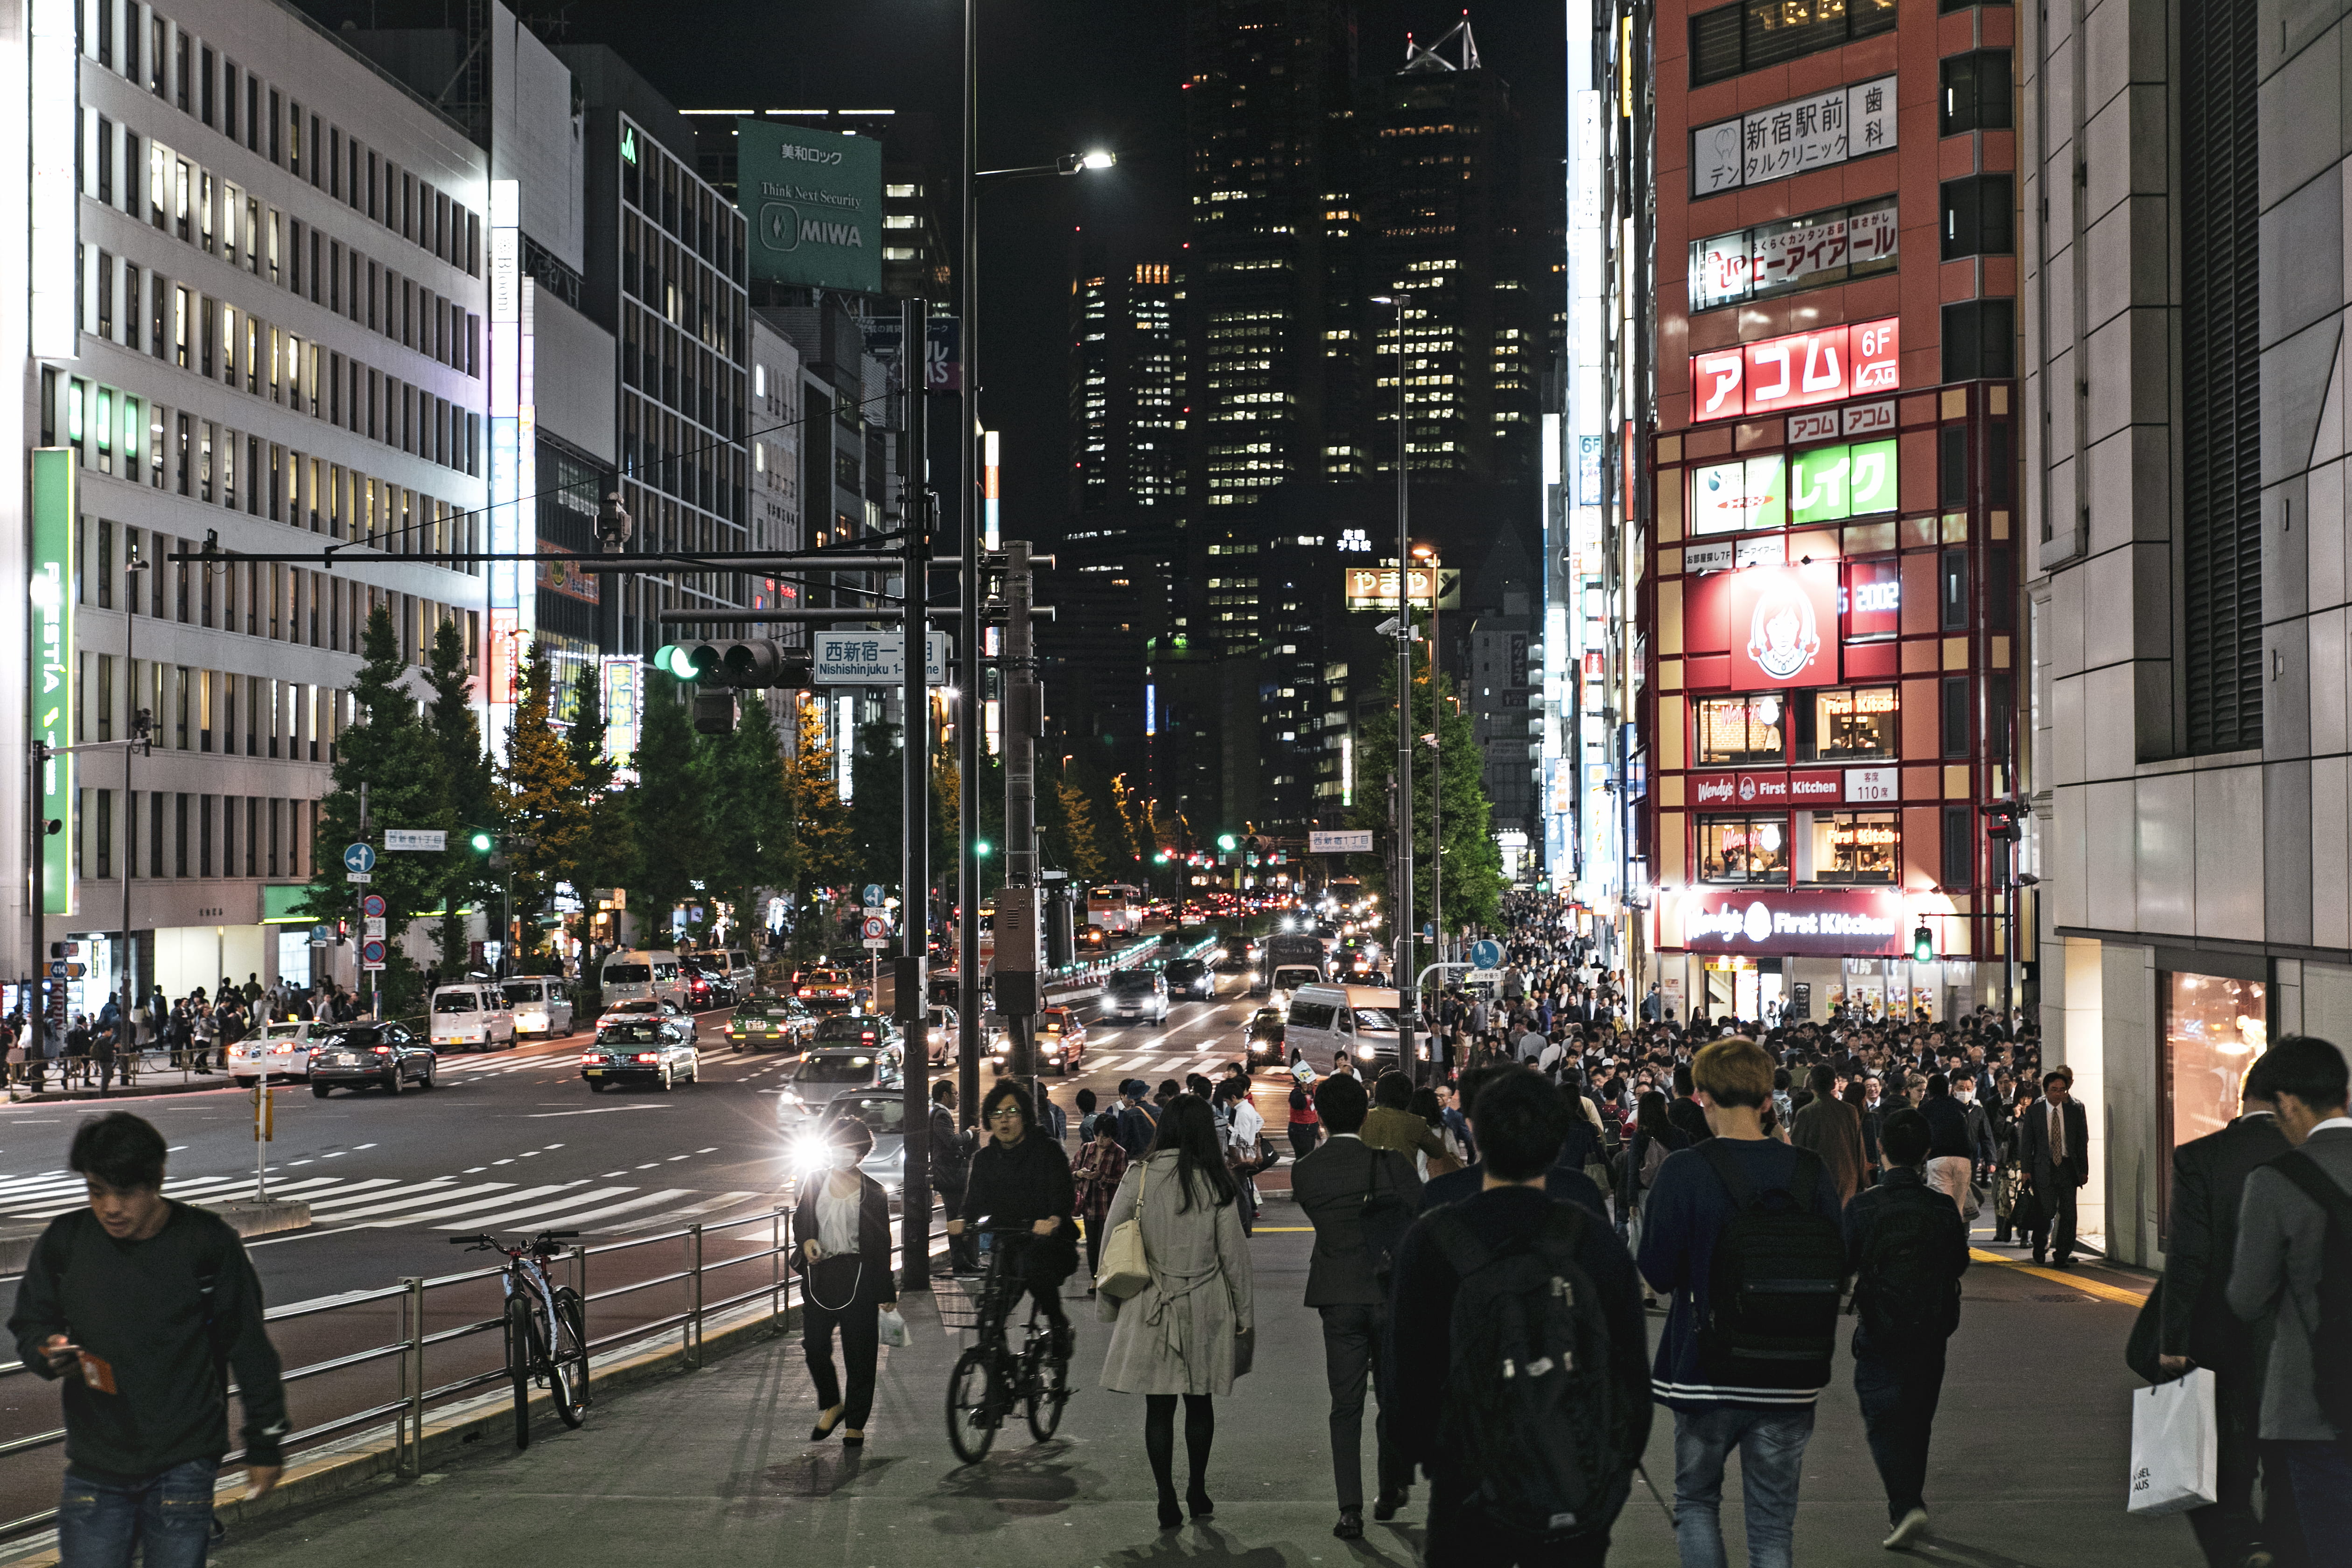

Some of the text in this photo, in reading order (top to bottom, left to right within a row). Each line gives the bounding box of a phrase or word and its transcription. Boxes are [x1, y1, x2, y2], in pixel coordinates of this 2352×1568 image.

[1747, 97, 1843, 152] 新宿駅前
[1865, 87, 1883, 147] 歯科
[782, 143, 841, 165] 美和ロック
[1711, 134, 1846, 188] デンタルクリニック
[761, 182, 861, 210] Think Next Security
[800, 220, 862, 248] MIWA
[1753, 226, 1896, 282] エーアイアール
[498, 258, 511, 311] Bloom
[1862, 327, 1891, 357] 6F
[1706, 338, 1841, 413] アコム
[1794, 415, 1834, 439] アコム
[1848, 406, 1890, 431] アコム
[1582, 438, 1600, 453] 6F
[1792, 452, 1885, 511] レイク
[1737, 545, 1783, 558] エーアイアール
[1354, 571, 1428, 595] やまや
[43, 562, 66, 693] PESTÍA
[826, 640, 932, 662] 西新宿一
[819, 663, 889, 677] Nishishinjuku
[1864, 772, 1879, 783] 客席
[1698, 778, 1837, 803] Wendy's First Kitchen
[1314, 835, 1368, 845] 西新宿1丁目
[1774, 912, 1819, 934] First
[1820, 913, 1896, 936] Kitchen
[52, 965, 66, 974] 414
[51, 983, 64, 1030] KIRIN
